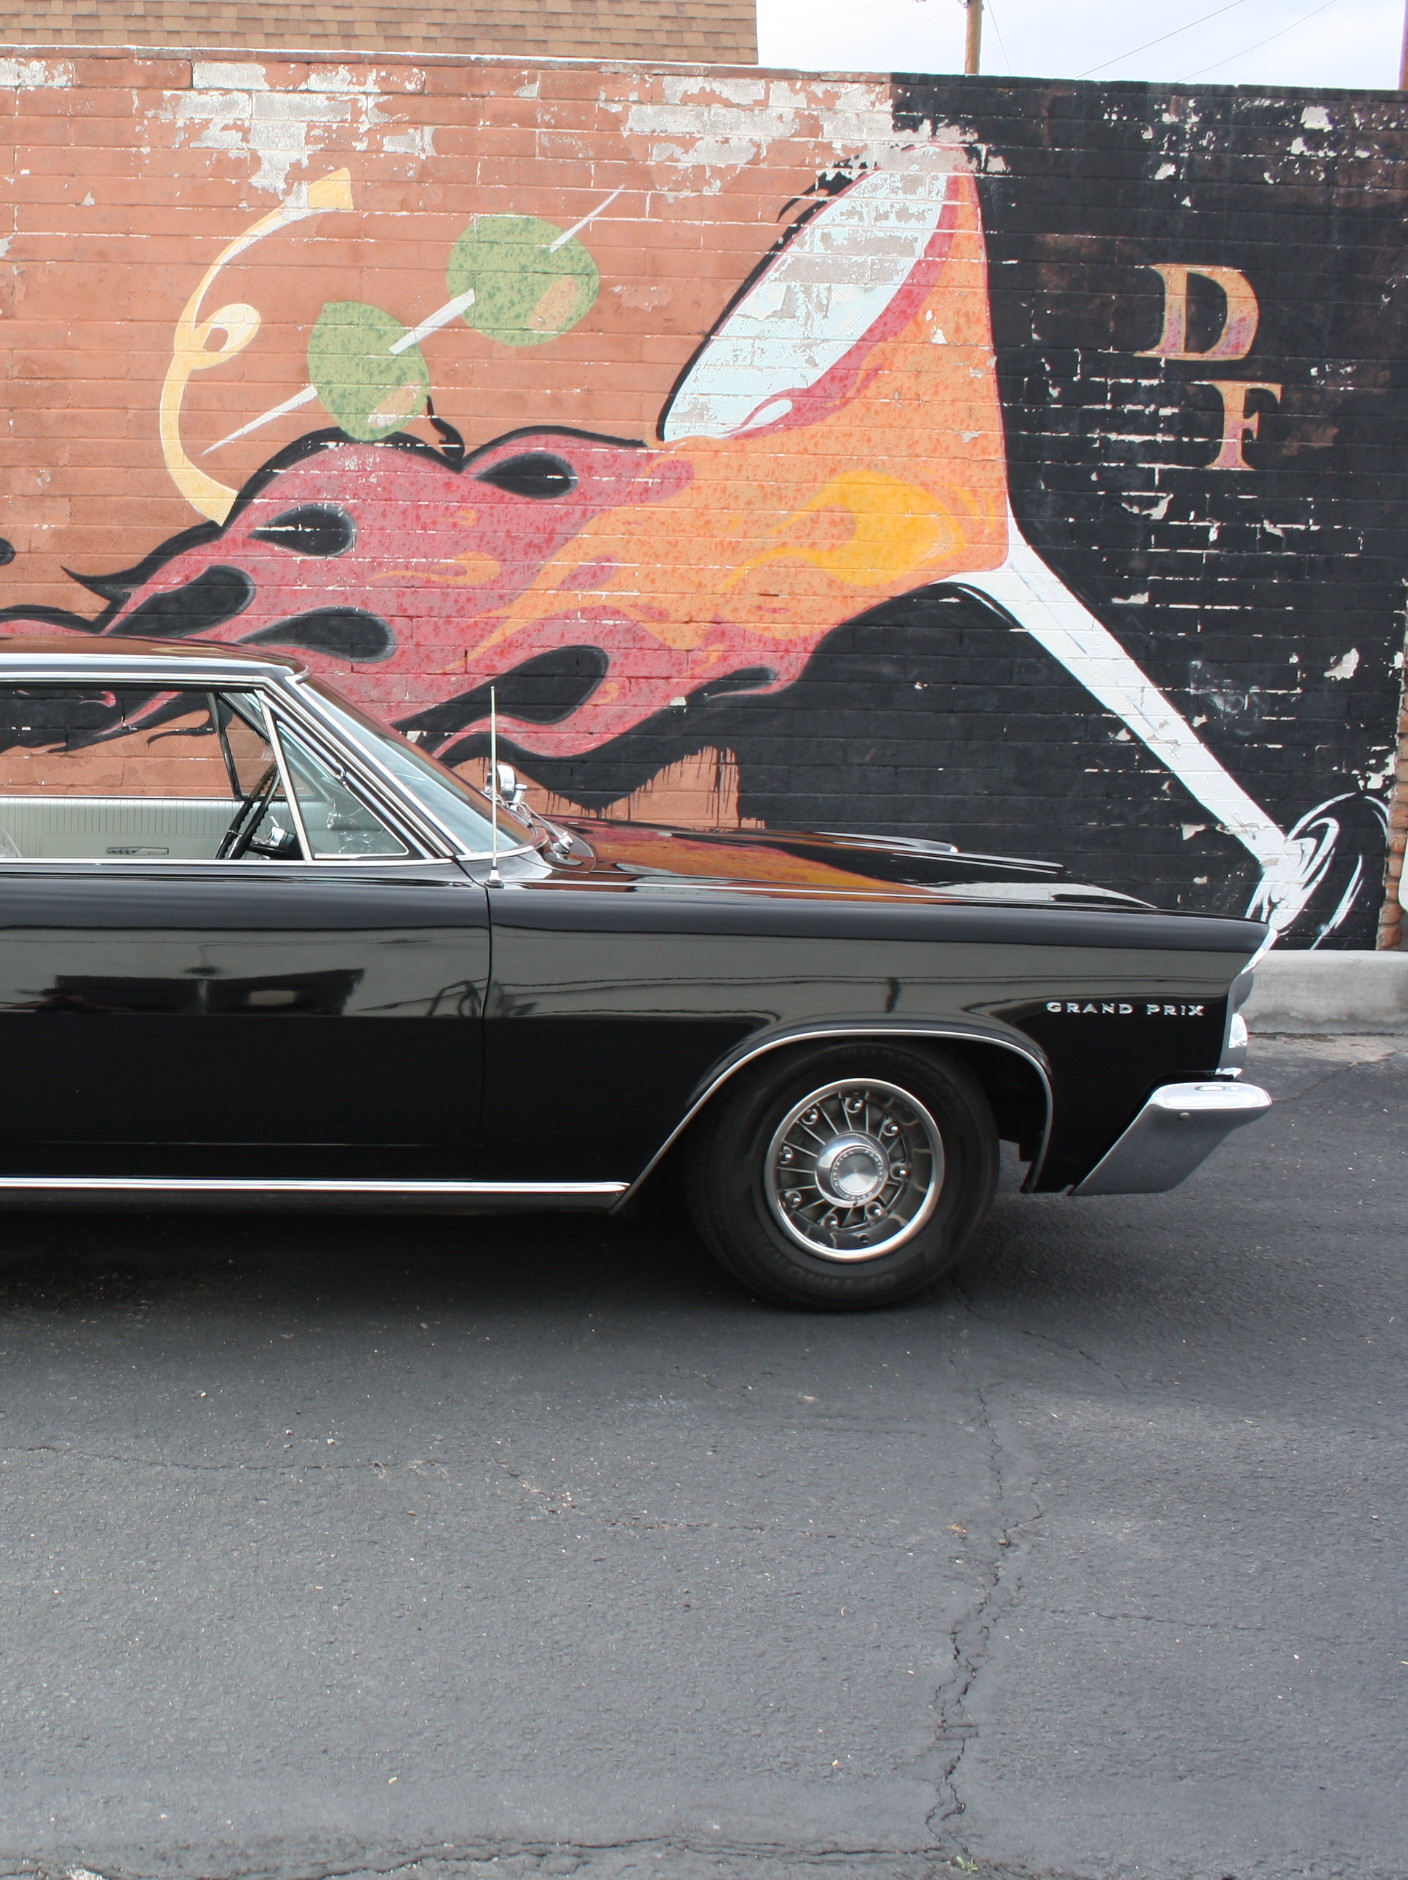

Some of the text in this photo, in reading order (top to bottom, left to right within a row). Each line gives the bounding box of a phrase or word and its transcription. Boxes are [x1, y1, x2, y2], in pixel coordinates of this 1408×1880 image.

[1132, 263, 1261, 361] D
[1204, 380, 1283, 471] F
[1046, 1001, 1204, 1016] GRAND PRIX
